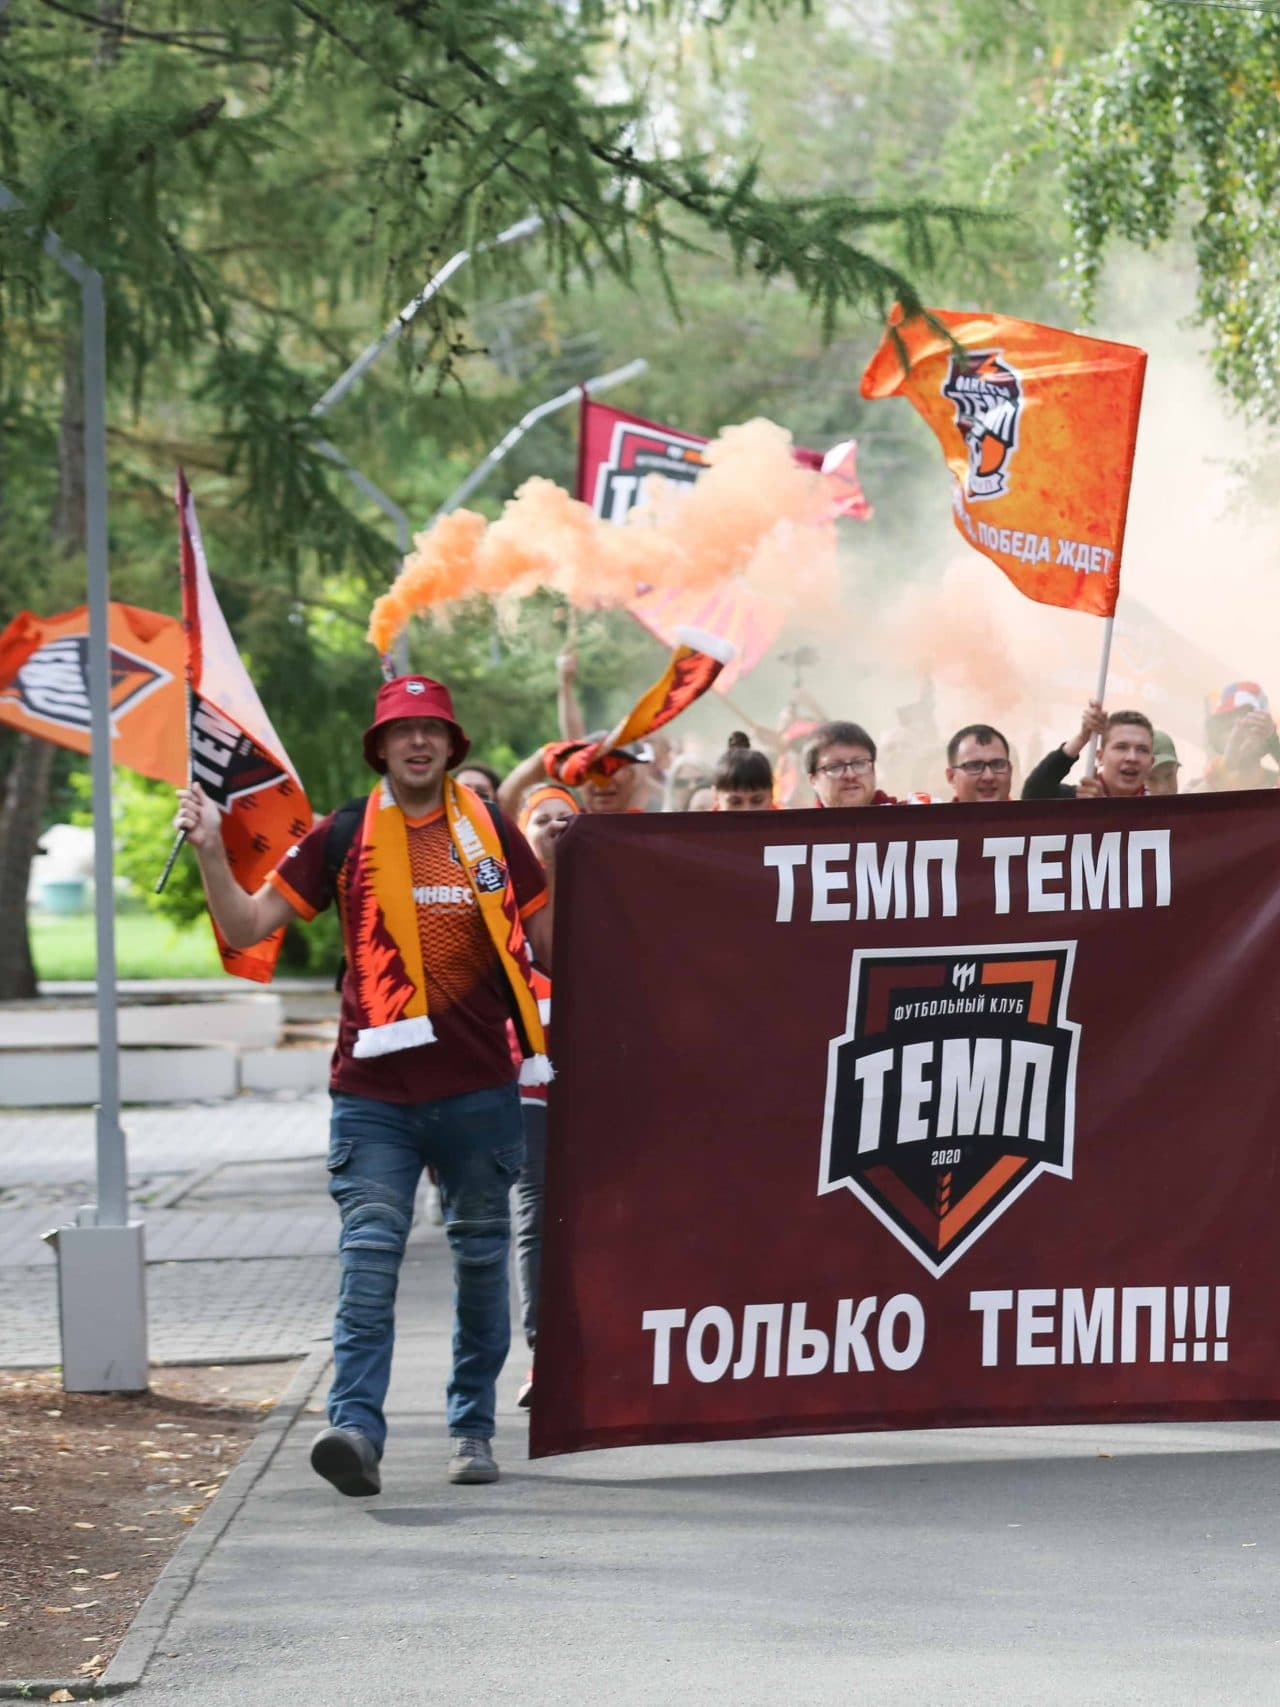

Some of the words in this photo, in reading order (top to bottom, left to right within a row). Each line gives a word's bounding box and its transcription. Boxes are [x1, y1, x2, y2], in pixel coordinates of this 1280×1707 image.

[977, 521, 1051, 565] ПОБЕДА
[763, 839, 959, 922] ТЕМП
[982, 829, 1171, 914] ТЕМП
[894, 995, 985, 1021] ФУТБОЛЬНЫЙ
[990, 997, 1024, 1014] КЛУБ
[854, 1037, 1054, 1155] ТЕМП
[931, 1148, 961, 1166] 2020
[641, 1293, 925, 1385] ТОЛЬКО
[969, 1285, 1231, 1367] ТЕМП!!!
